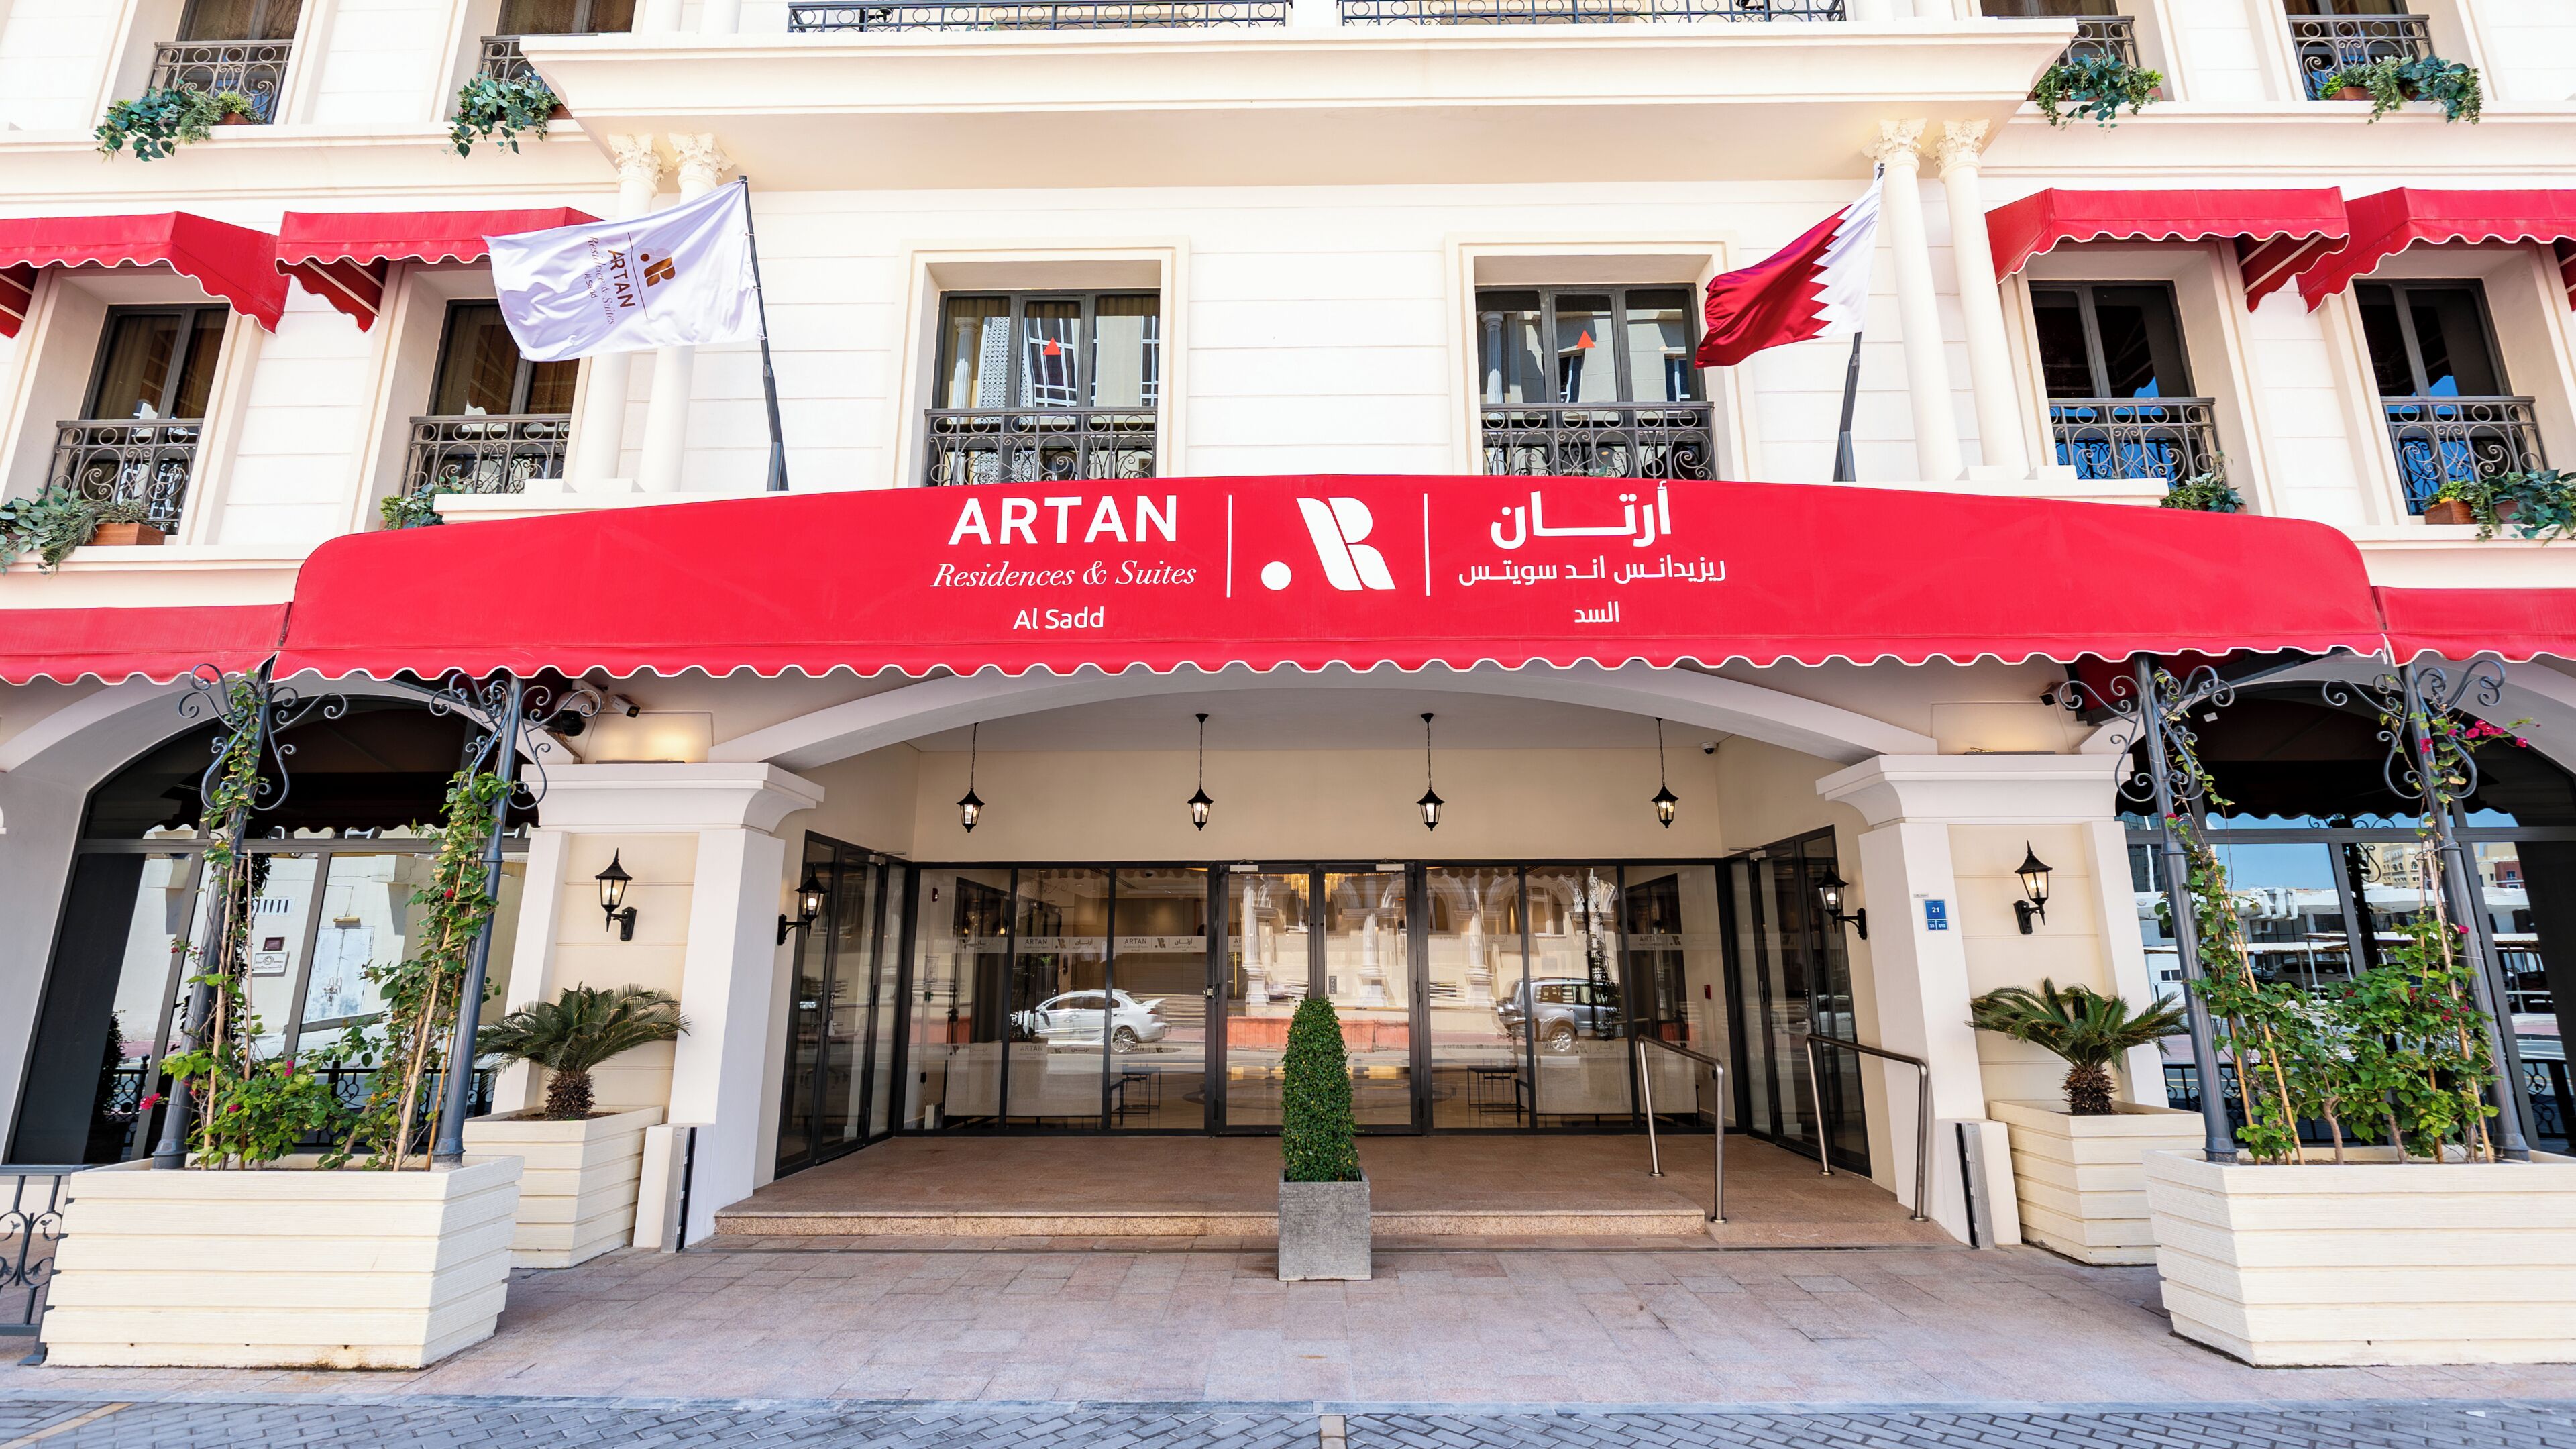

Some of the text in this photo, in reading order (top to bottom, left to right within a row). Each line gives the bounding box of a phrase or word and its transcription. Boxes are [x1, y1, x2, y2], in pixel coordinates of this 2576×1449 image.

[585, 280, 598, 299] Sadd
[608, 249, 636, 308] ARTAN
[602, 297, 616, 325] Suites
[948, 494, 1177, 545] ARTAN
[1490, 480, 1672, 549] أرتان
[930, 560, 1197, 587] Residences & Suites
[1458, 554, 1726, 586] ريزيدانس اند سويتس
[1012, 606, 1104, 630] Al Sadd
[1574, 600, 1620, 623] السد
